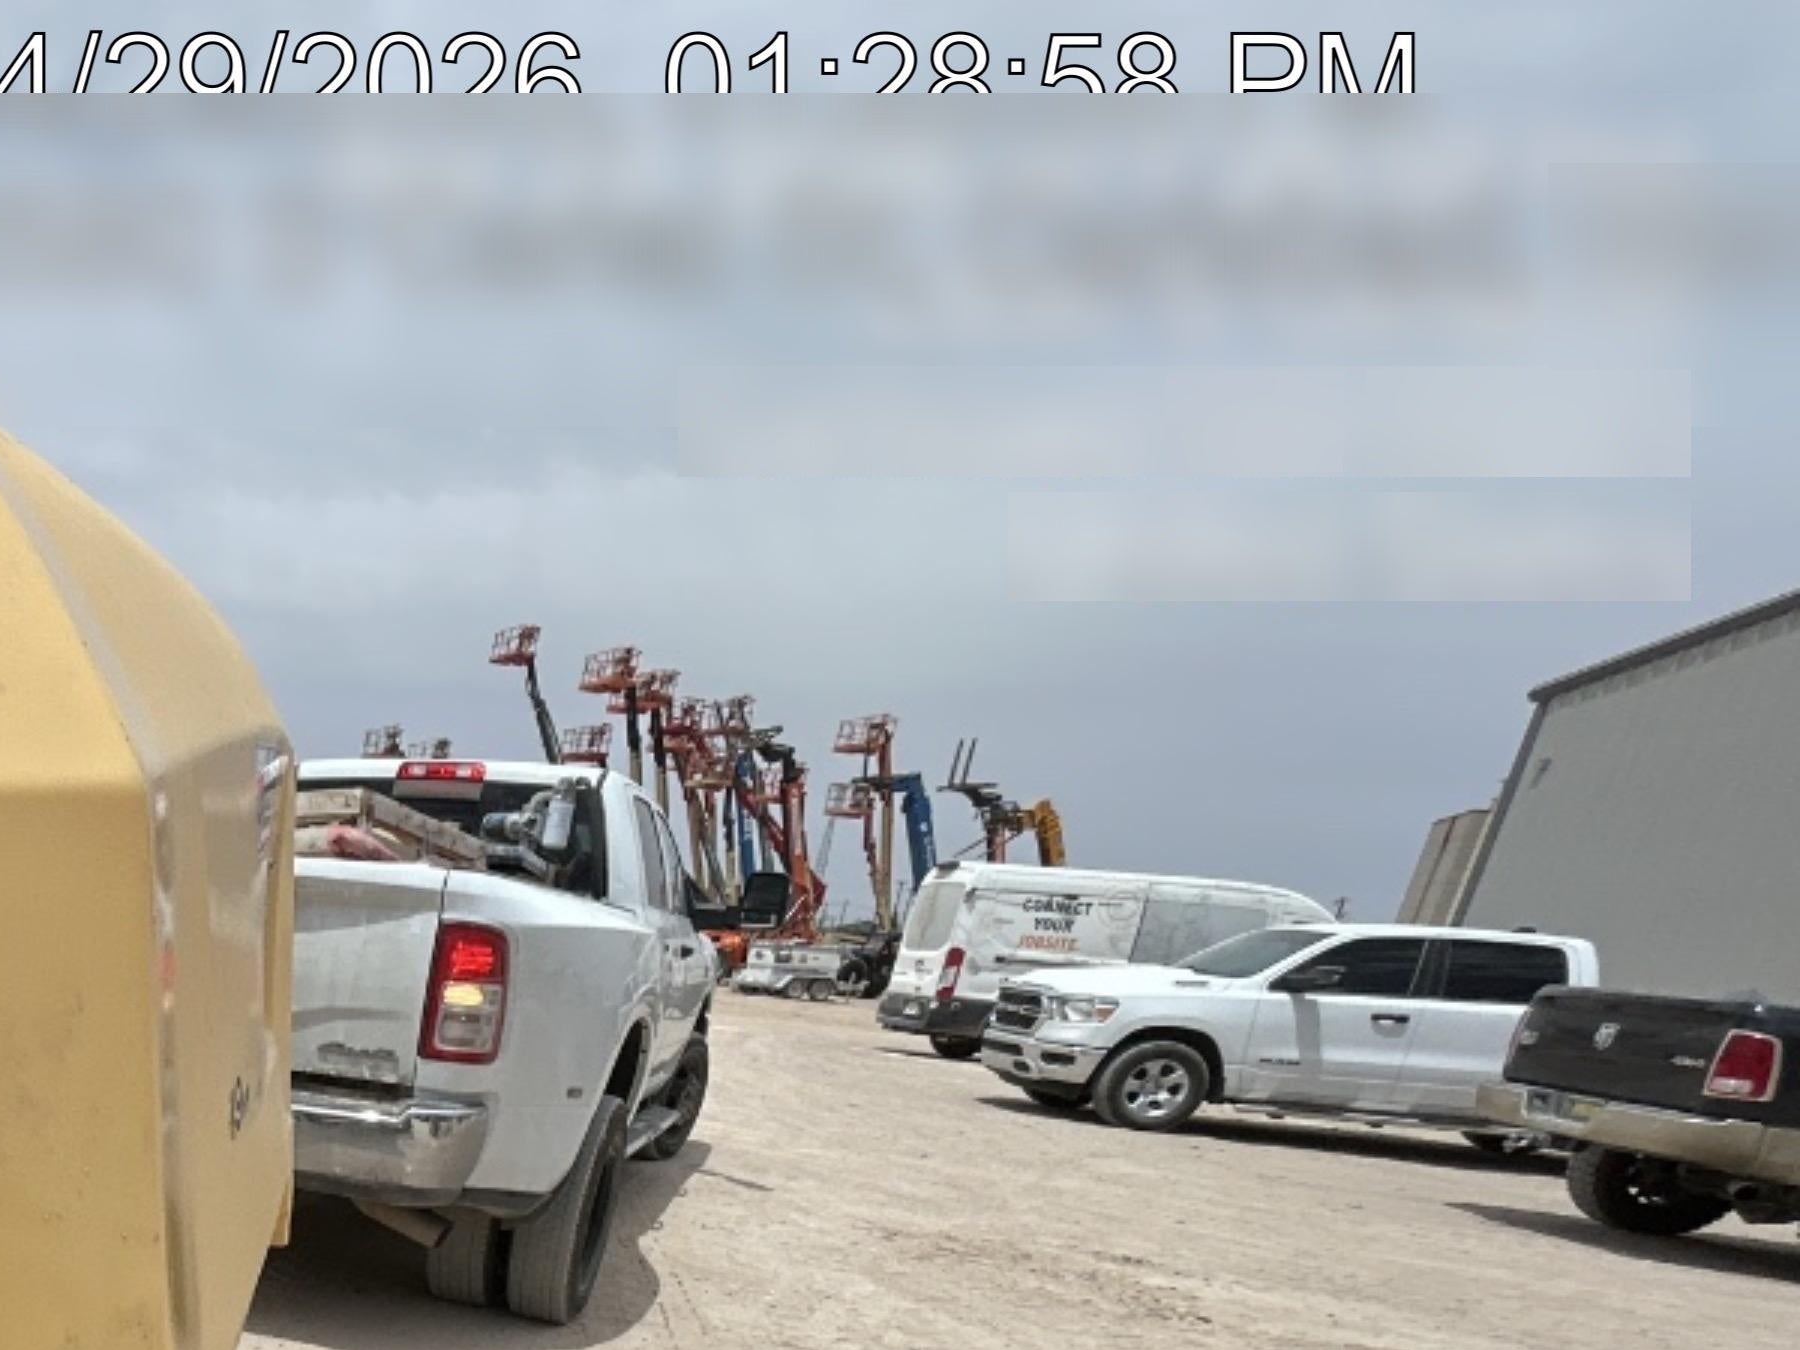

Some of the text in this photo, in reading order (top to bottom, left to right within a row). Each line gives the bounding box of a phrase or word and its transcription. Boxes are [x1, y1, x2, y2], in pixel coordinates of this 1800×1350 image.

[1022, 898, 1093, 916] CONNECT
[1034, 917, 1075, 933] YOUR
[1017, 935, 1079, 951] JOBSITE
